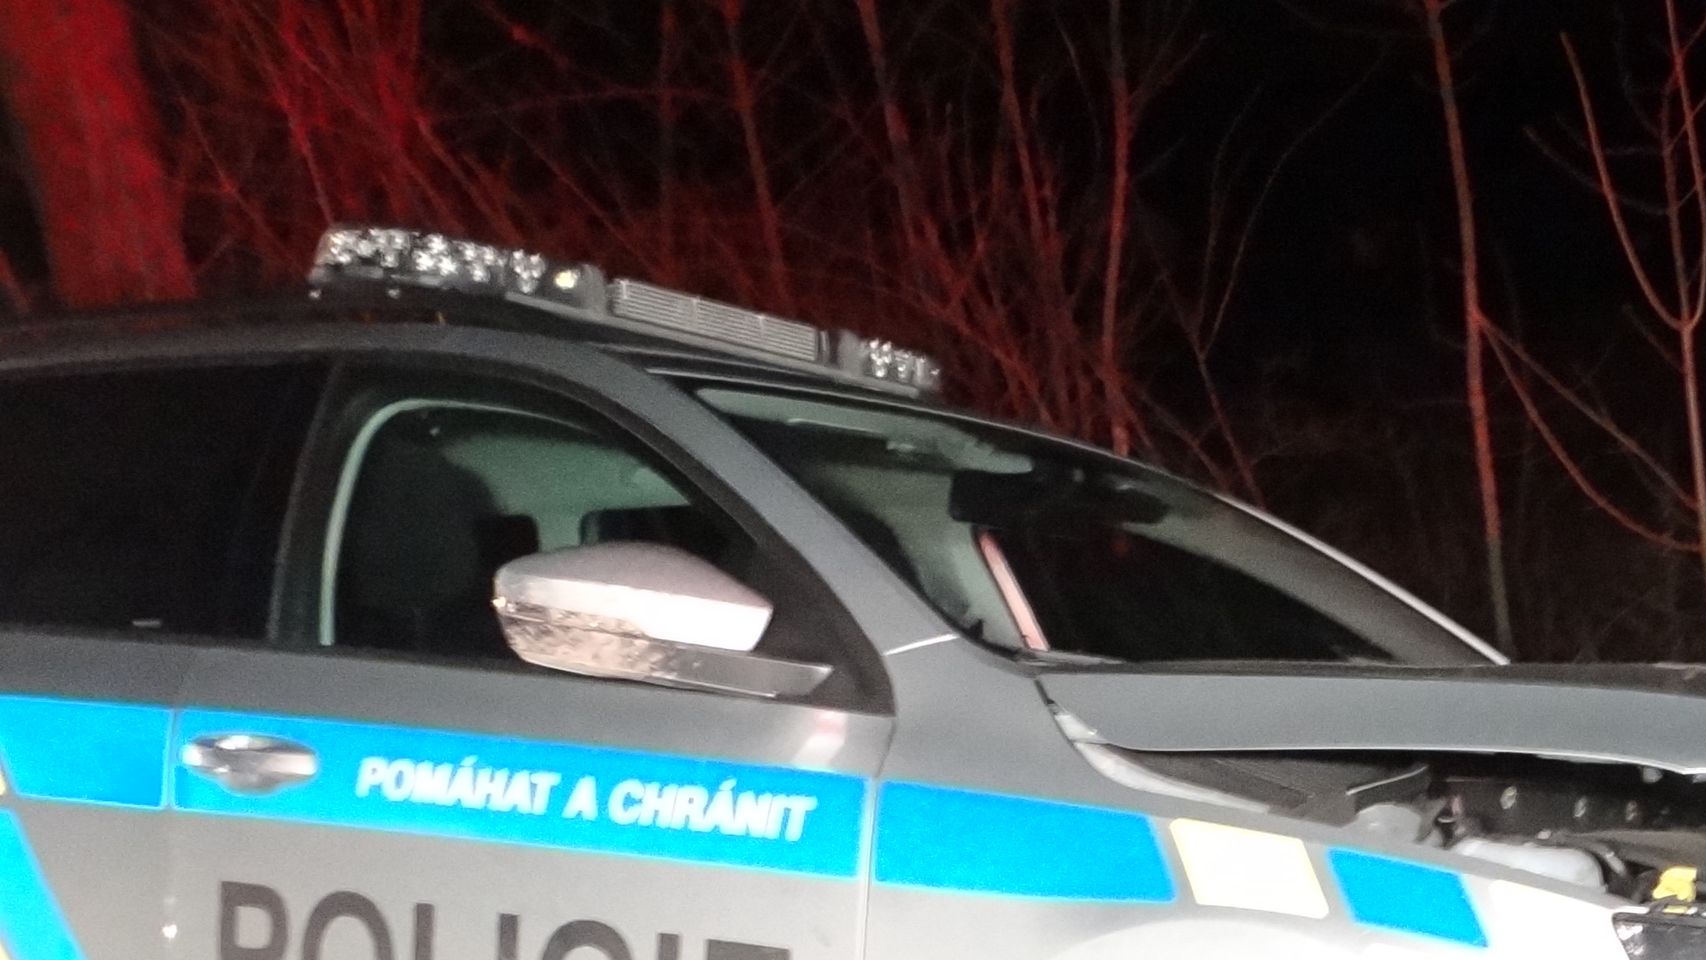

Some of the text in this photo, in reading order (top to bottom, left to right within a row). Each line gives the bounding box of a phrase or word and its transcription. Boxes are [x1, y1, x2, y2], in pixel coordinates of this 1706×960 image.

[355, 755, 819, 841] POMÁHAT A CHRÁNIT
